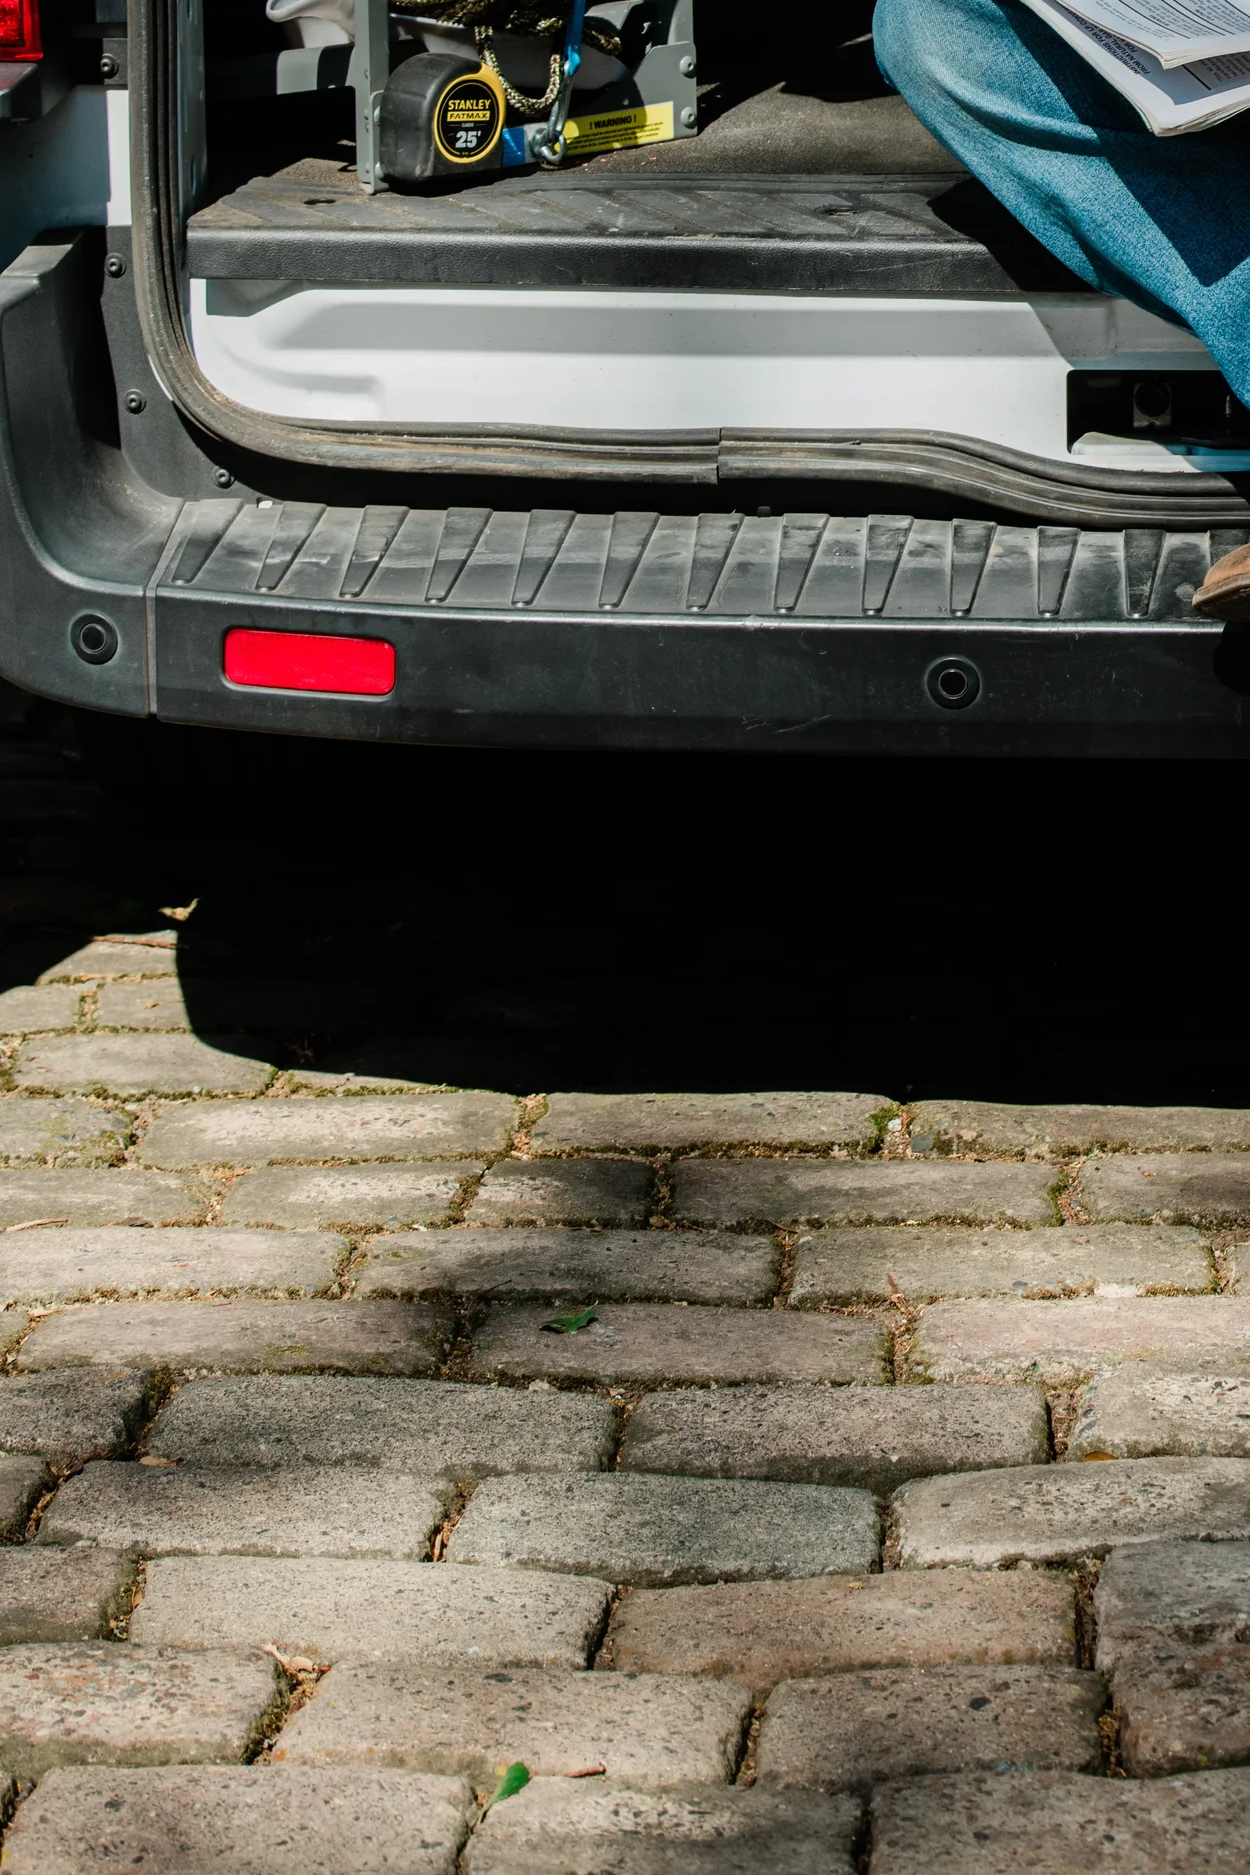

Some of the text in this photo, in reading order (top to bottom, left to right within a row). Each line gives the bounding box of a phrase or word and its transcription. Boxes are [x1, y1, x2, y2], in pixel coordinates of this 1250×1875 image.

[1084, 24, 1094, 33] LP
[1091, 31, 1105, 43] FOR
[1111, 39, 1135, 61] NATURAL
[1125, 42, 1137, 53] FOR
[1102, 41, 1141, 75] INSTRUCTIONS
[1132, 59, 1151, 75] FROM
[448, 100, 491, 110] STANLEY
[594, 116, 632, 129] WARNING
[455, 131, 481, 148] 25'
